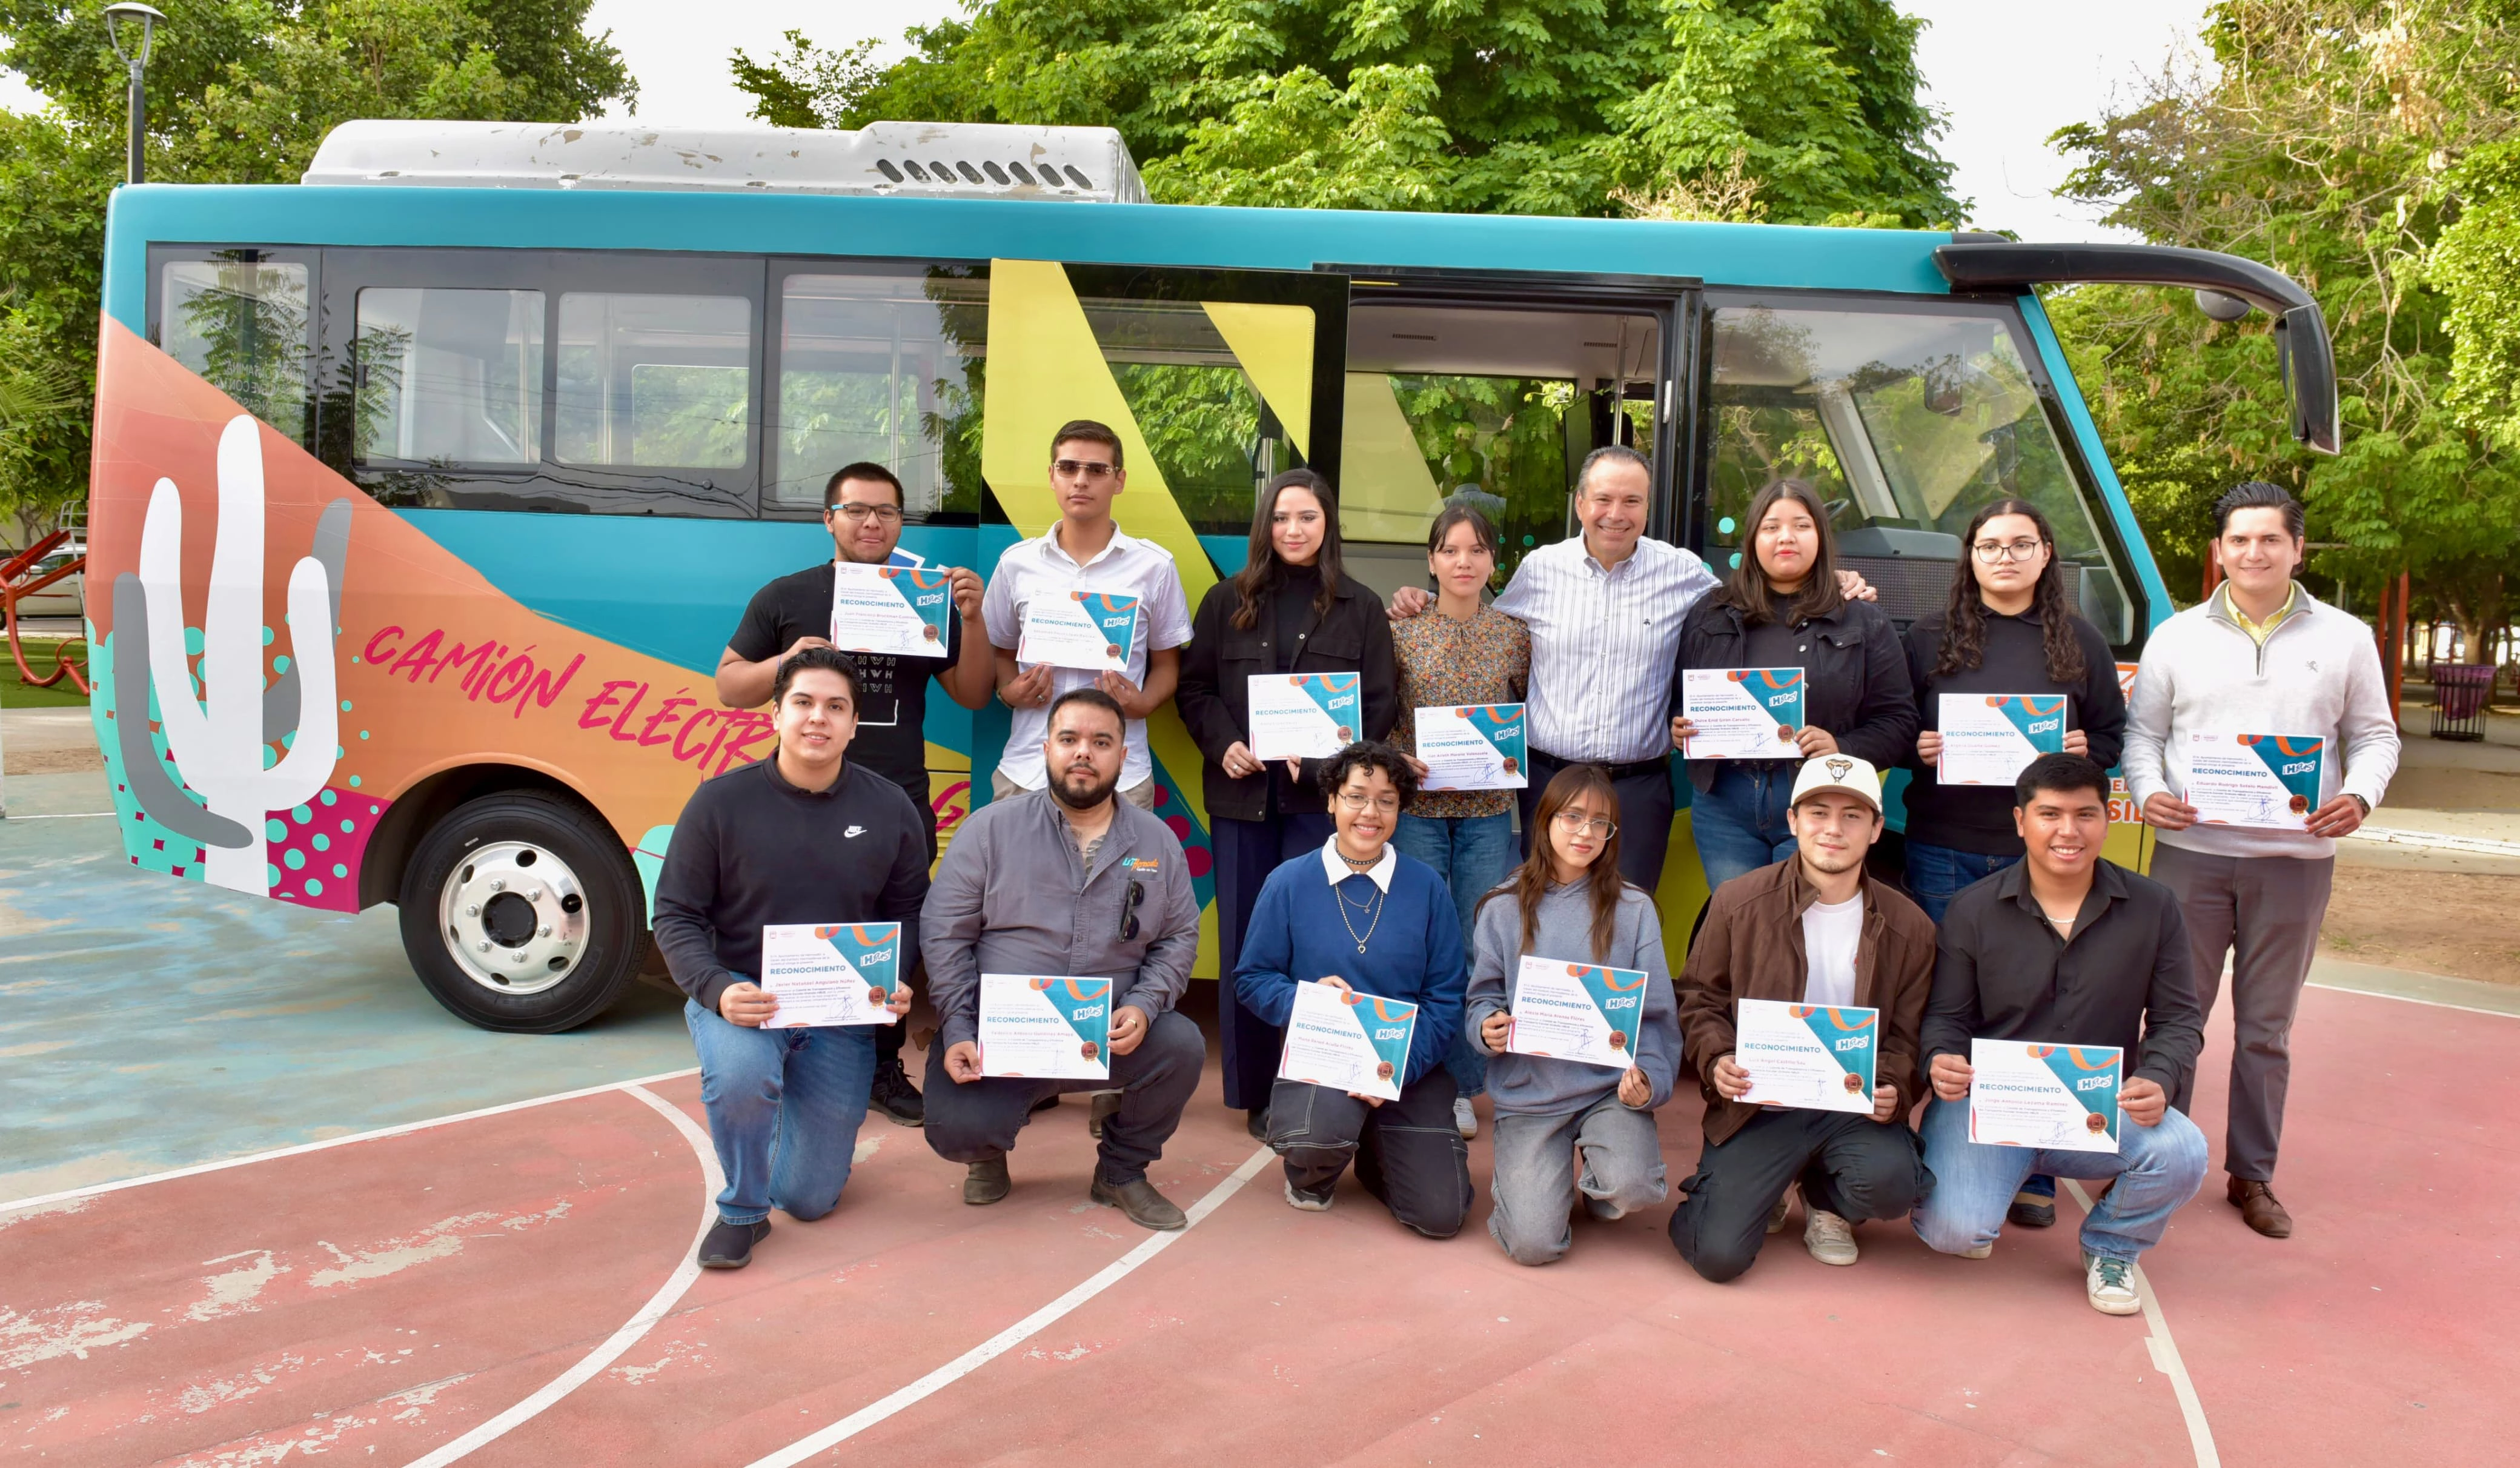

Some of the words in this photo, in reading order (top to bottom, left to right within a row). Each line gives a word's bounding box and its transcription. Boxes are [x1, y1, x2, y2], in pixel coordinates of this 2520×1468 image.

[840, 599, 904, 608] RECONOCIMIENTO
[1032, 618, 1092, 628] RECONOCIMIENTO
[578, 680, 774, 777] ELÉCTR
[2192, 768, 2267, 777] RECONOCIMIENTO
[770, 965, 846, 975] RECONOCIMIENTO
[1522, 996, 1591, 1011] RECONOCIMIENTO
[1296, 1023, 1362, 1039] RECONOCIMIENTO
[1745, 1043, 1820, 1053] RECONOCIMIENTO
[1980, 1083, 2061, 1094] RECONOCIMIENTO
